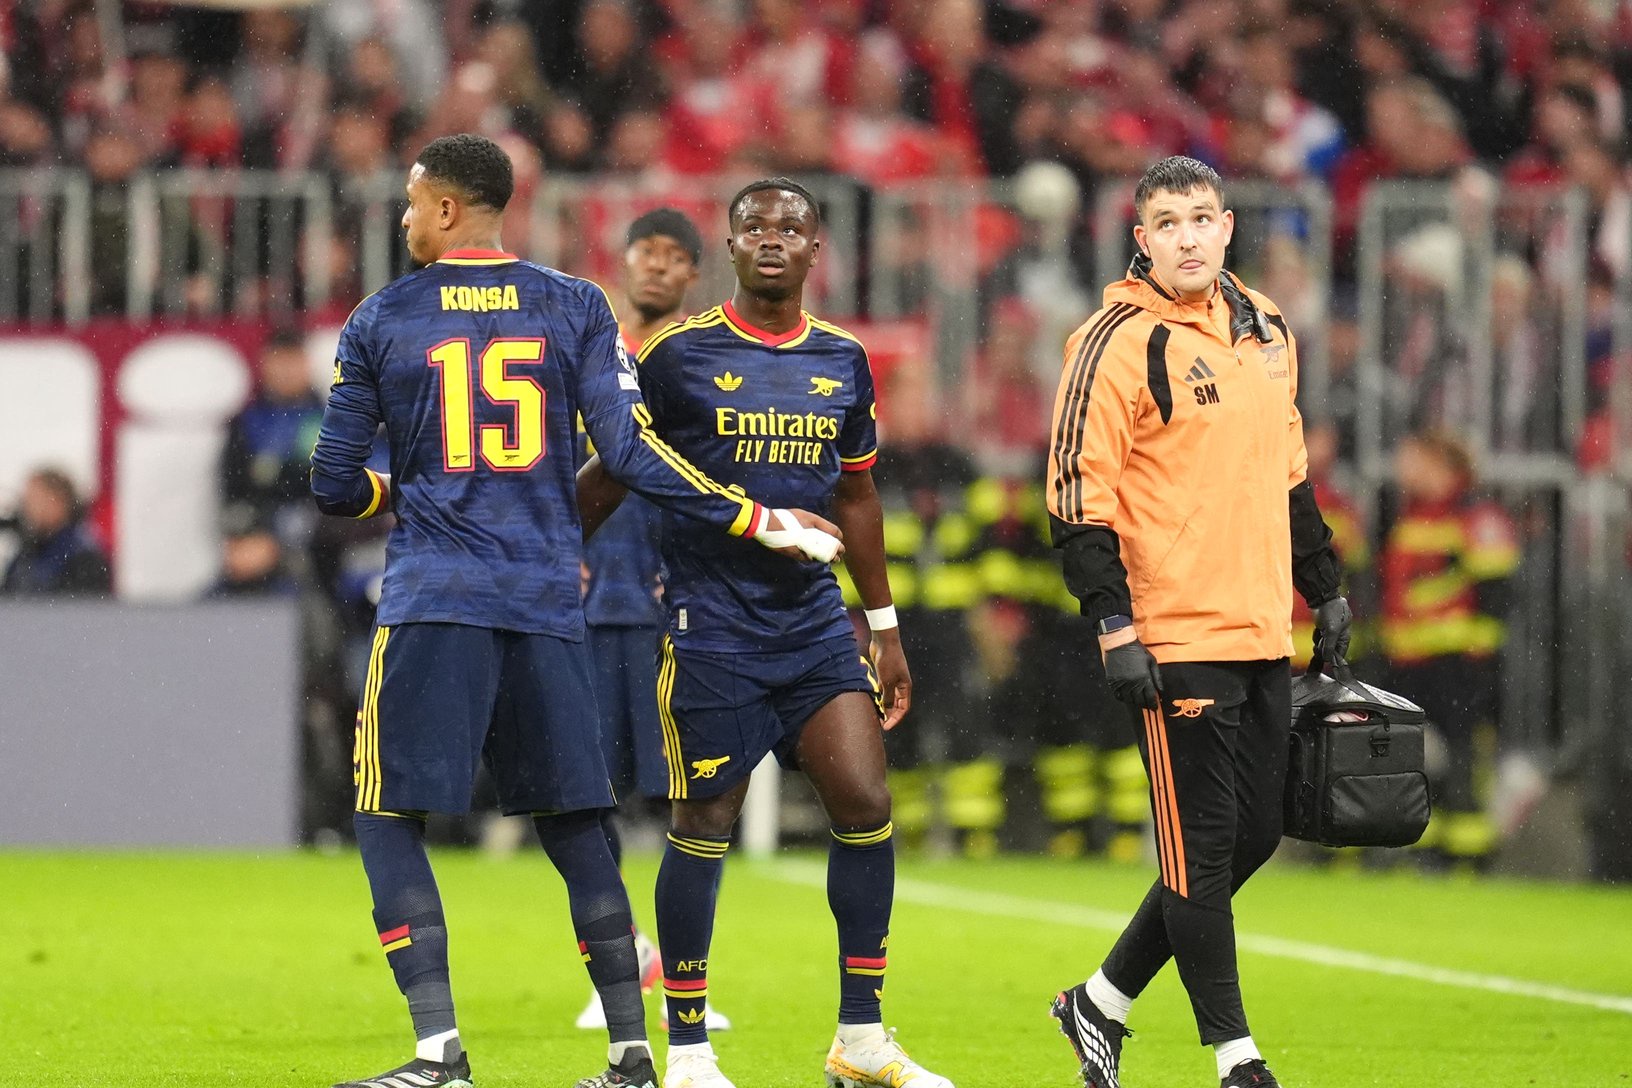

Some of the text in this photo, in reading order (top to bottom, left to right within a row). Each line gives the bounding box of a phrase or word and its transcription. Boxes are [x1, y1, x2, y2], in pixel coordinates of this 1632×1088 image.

[440, 285, 519, 312] KONSA
[427, 337, 546, 472] 15
[1194, 383, 1220, 406] SM
[715, 407, 838, 440] Emirates
[735, 439, 822, 465] FLY BETTER
[677, 959, 707, 972] AFC
